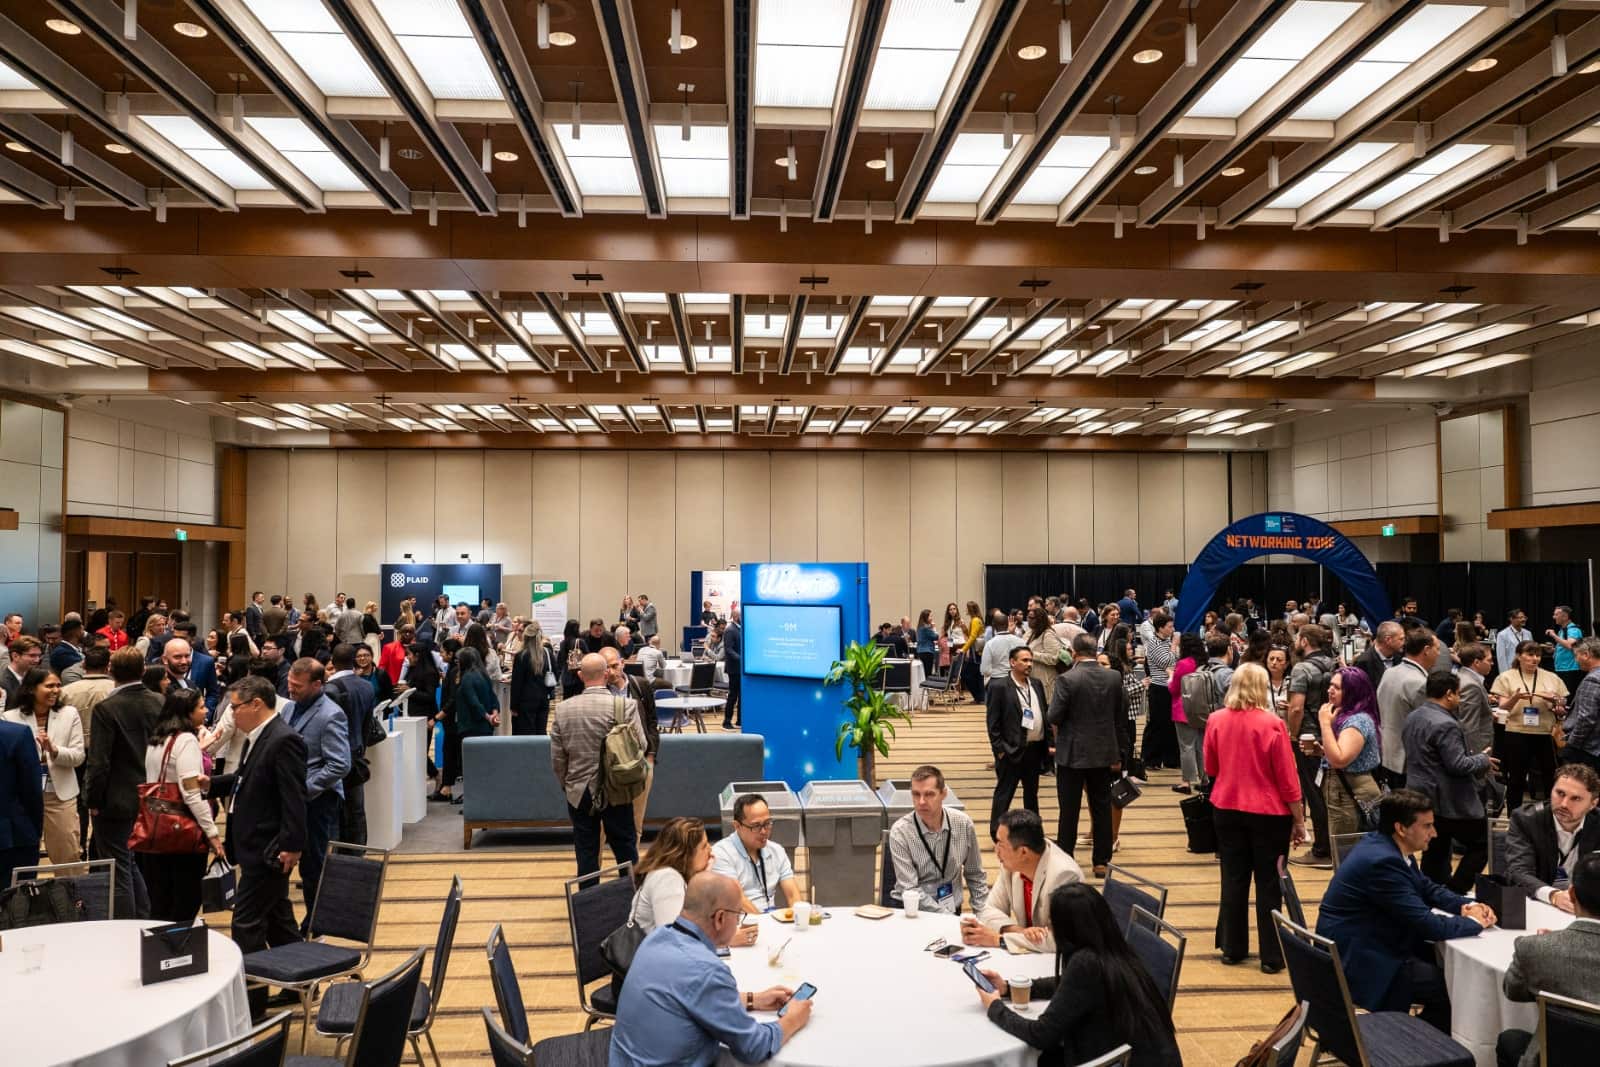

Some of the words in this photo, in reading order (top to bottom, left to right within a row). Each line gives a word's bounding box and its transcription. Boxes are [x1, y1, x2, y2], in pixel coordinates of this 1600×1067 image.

[1226, 534, 1303, 549] NETWORKING
[1306, 536, 1335, 549] ZONE
[406, 576, 429, 584] PLAID
